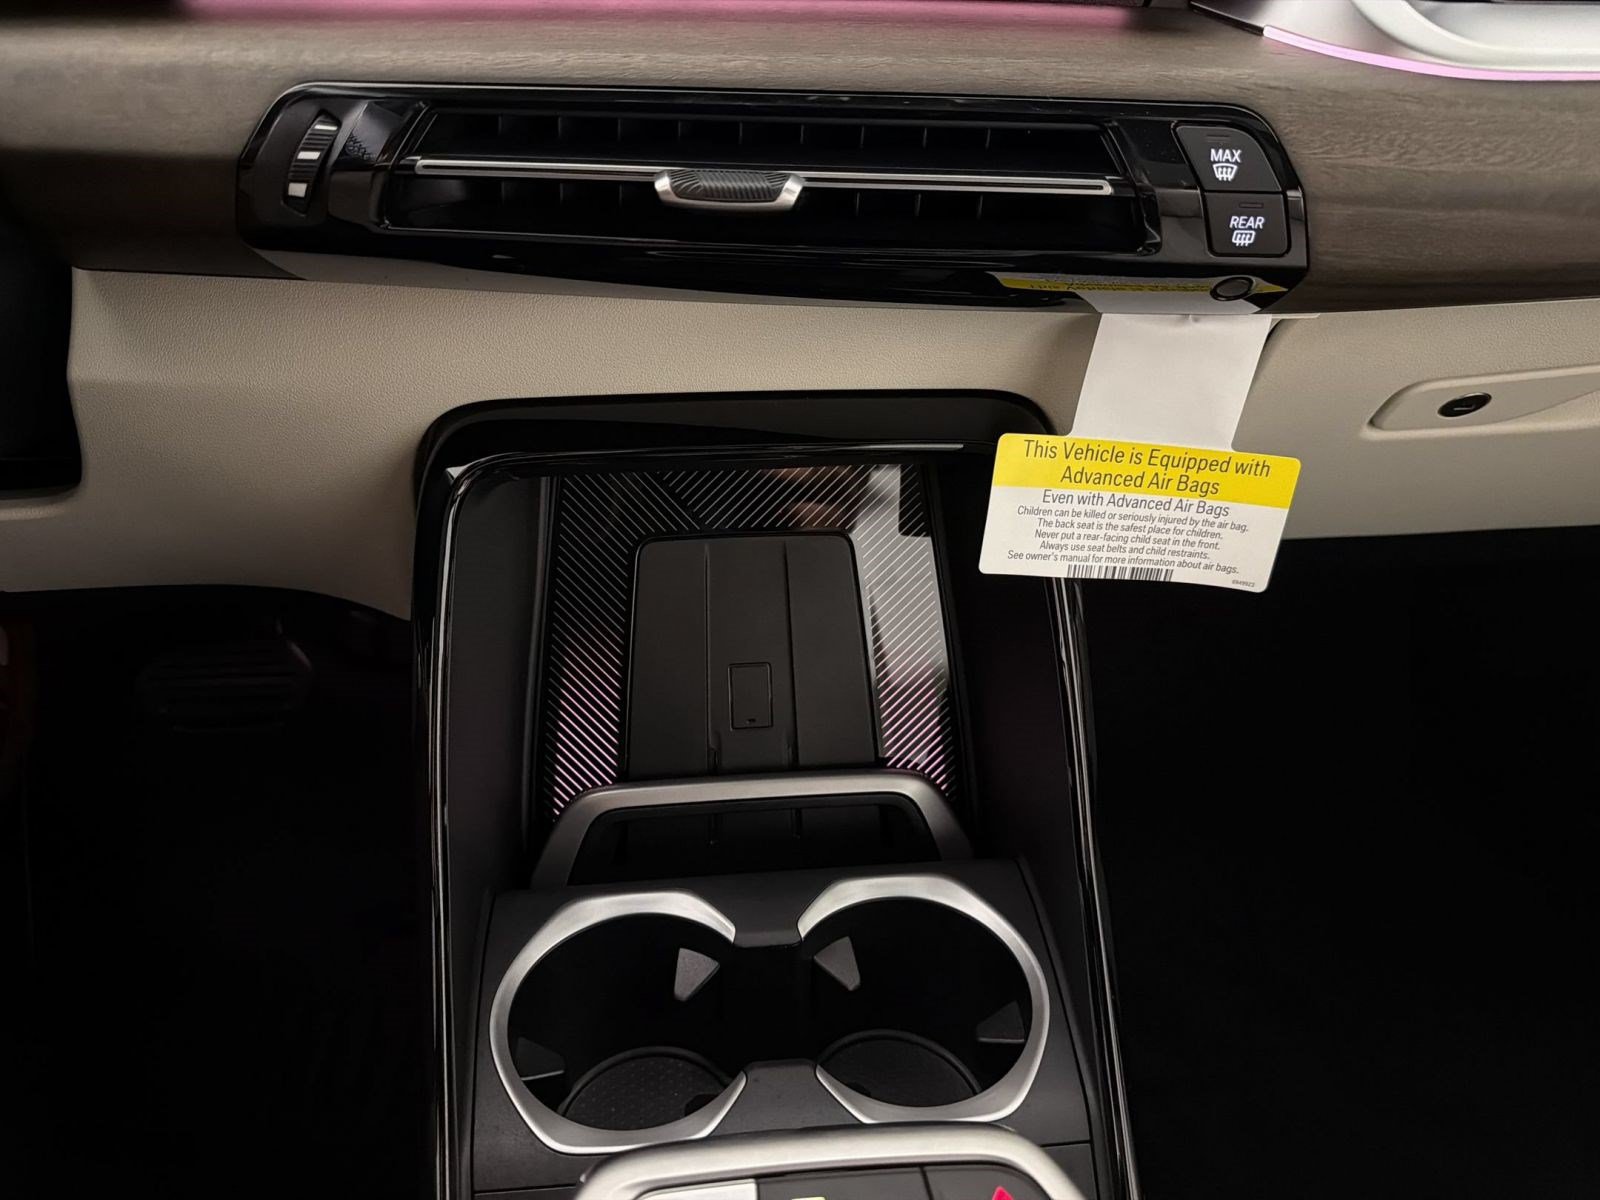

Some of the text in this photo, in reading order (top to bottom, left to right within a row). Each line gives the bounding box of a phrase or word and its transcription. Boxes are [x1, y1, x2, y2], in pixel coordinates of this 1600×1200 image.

[1210, 148, 1242, 162] MAX
[1230, 216, 1265, 229] REAR
[1024, 440, 1270, 478] This Vehicle is Equipped with
[1060, 466, 1220, 497] Advanced Air Bags
[1042, 489, 1230, 519] Even with Advanced Air Bags
[1017, 505, 1052, 516] Children
[1054, 509, 1070, 518] can
[1072, 508, 1082, 518] be
[1084, 509, 1106, 520] killed
[1118, 512, 1156, 524] seriously
[1158, 515, 1187, 526] injured
[1189, 516, 1200, 528] by
[1201, 518, 1216, 528] the
[1217, 520, 1230, 529] air
[1230, 521, 1248, 533] bag.
[1038, 518, 1223, 540] The back seat is the safest place for children.
[1035, 529, 1060, 539] Never
[1060, 531, 1075, 541] put
[1083, 532, 1129, 544] rear-facing
[1130, 535, 1151, 544] child
[1152, 536, 1171, 545] seat
[1172, 537, 1181, 546] in
[1182, 538, 1196, 547] the
[1197, 540, 1220, 550] front.
[1040, 540, 1210, 560] Always use seat belts and child restraints.
[1008, 550, 1024, 560] See
[1026, 552, 1058, 561] owner's
[1060, 553, 1091, 563] manual
[1092, 554, 1103, 563] for
[1128, 556, 1175, 567] information
[1177, 560, 1201, 570] about
[1203, 561, 1214, 571] air
[1216, 563, 1239, 574] bags.
